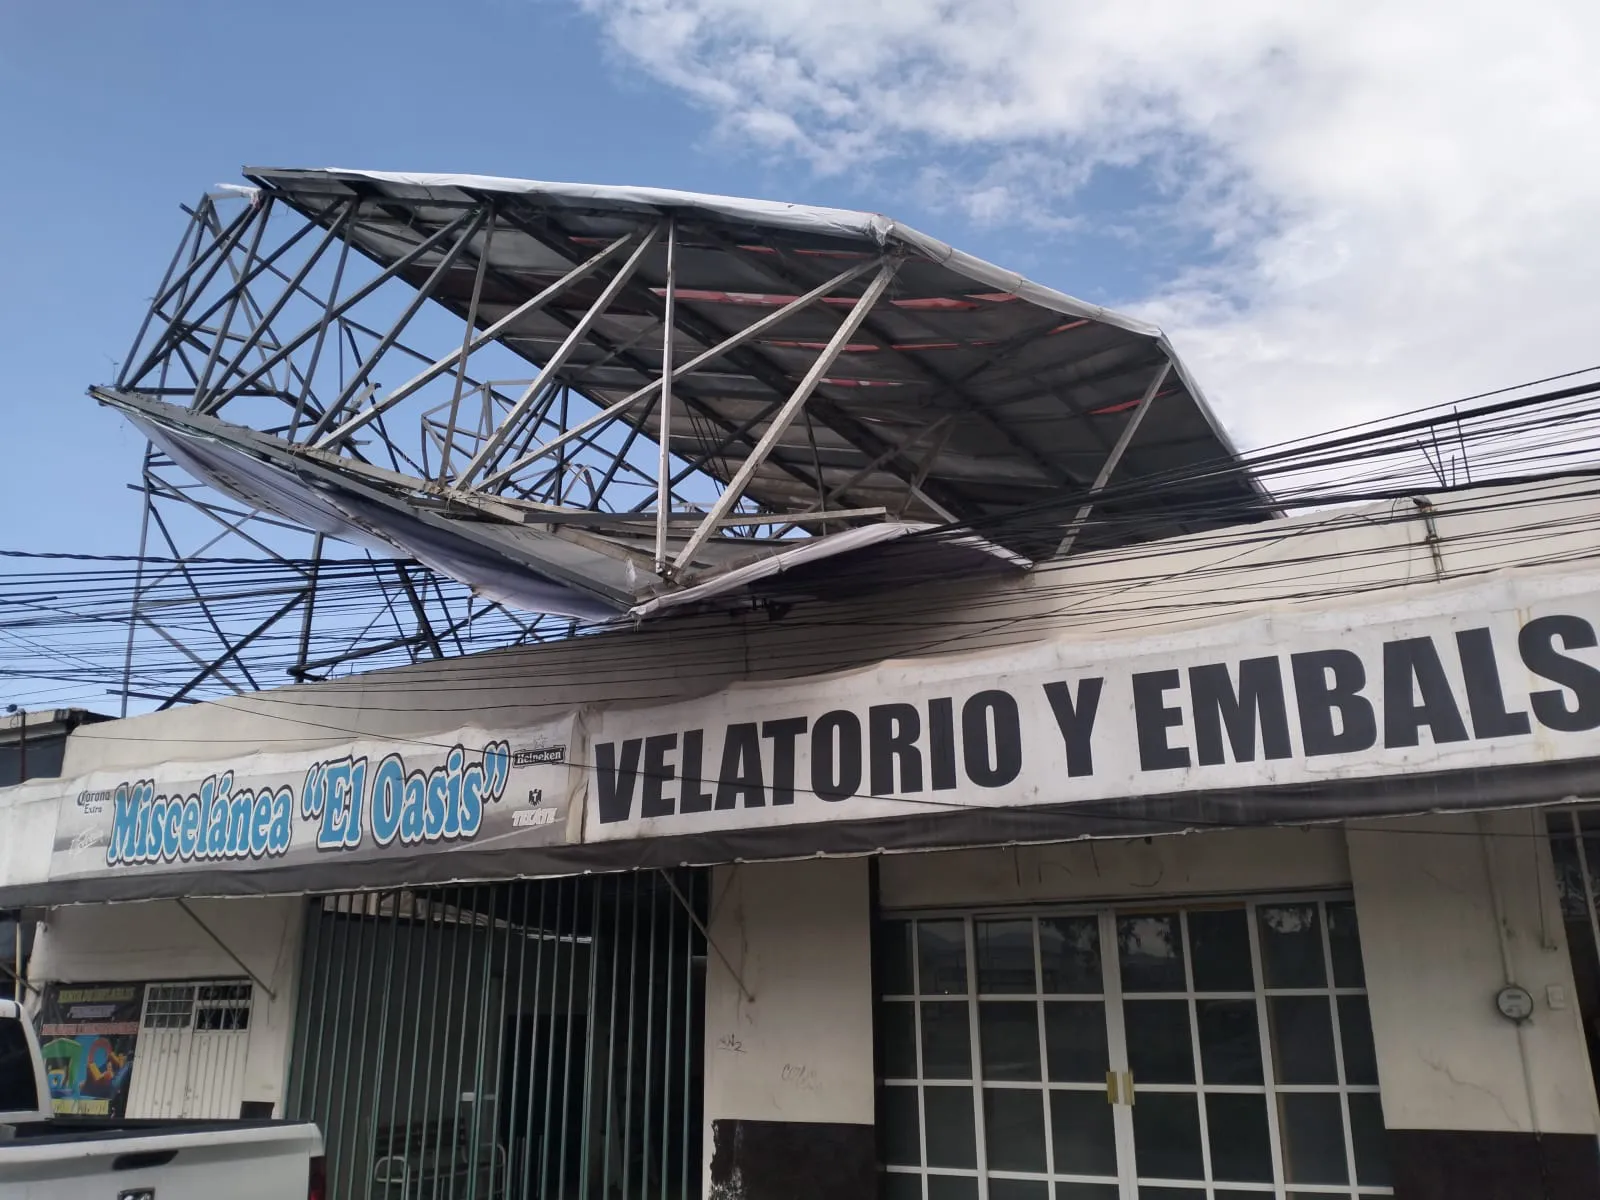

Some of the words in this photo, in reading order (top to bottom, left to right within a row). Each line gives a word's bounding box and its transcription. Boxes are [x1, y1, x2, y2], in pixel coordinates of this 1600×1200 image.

[595, 689, 1023, 825] VELATORIO
[1043, 676, 1104, 778] Y
[1131, 614, 1600, 772] EMBALS
[515, 750, 563, 765] Heineken
[77, 790, 110, 806] Corona
[84, 803, 102, 814] Extra
[106, 770, 294, 867] Miscelánea
